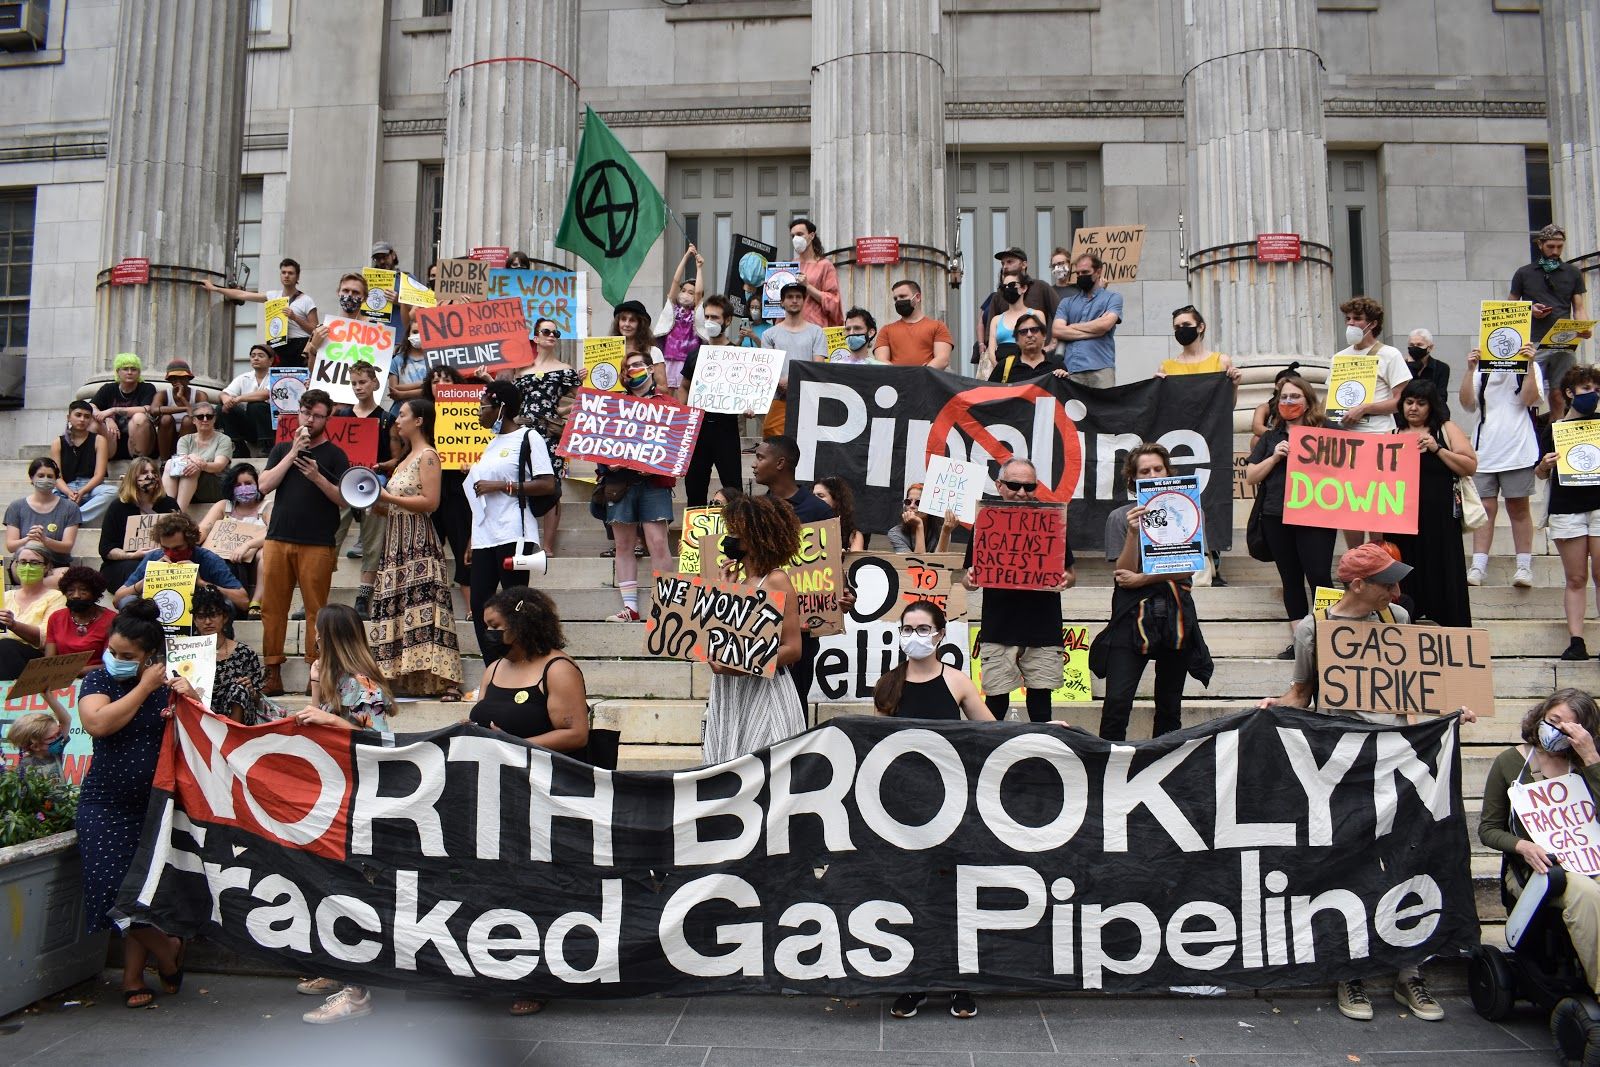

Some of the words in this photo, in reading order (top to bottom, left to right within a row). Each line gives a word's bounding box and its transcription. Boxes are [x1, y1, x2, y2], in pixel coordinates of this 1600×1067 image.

[1079, 232, 1099, 244] WE
[1106, 230, 1143, 243] WONT
[1109, 247, 1126, 261] TO
[441, 263, 463, 279] NO
[467, 263, 490, 281] BK
[440, 281, 483, 295] PIPELINE
[467, 301, 523, 322] NORTH
[527, 298, 573, 318] FOR
[327, 319, 392, 350] GRID'S
[420, 311, 464, 342] NO
[469, 319, 529, 337] BROOKLYN
[325, 342, 376, 365] GAS
[426, 343, 501, 368] PIPELINE
[707, 350, 720, 360] WE
[581, 393, 612, 415] WE
[618, 398, 680, 425] WON'T
[573, 412, 610, 434] PAY
[613, 420, 637, 438] TO
[642, 424, 670, 443] BE
[437, 436, 471, 444] DONT
[567, 433, 667, 465] POISONED
[439, 452, 482, 463] STRIK
[1297, 434, 1364, 469] SHUT
[1376, 442, 1404, 472] IT
[947, 463, 964, 474] NO
[936, 472, 968, 489] NBK
[933, 486, 965, 500] PIPE
[1286, 471, 1406, 516] DOWN
[980, 509, 1059, 533] STRIKE
[976, 531, 1056, 554] AGAINST
[976, 553, 1048, 569] RACIST
[906, 566, 938, 590] TO
[973, 566, 1063, 588] PIPELINES
[656, 576, 691, 608] WE
[691, 585, 784, 637] WON'T
[798, 592, 838, 615] PELINES
[168, 651, 197, 663] Green
[707, 627, 779, 676] PAY!
[1331, 626, 1407, 666] GAS
[1418, 633, 1486, 668] BILL
[1323, 665, 1441, 714] STRIKE
[175, 710, 614, 867] NORTH
[673, 718, 1458, 867] BROOKLYN
[1528, 781, 1568, 808] NO
[1520, 800, 1597, 833] FRACKED
[1549, 827, 1589, 850] GAS
[136, 797, 622, 983] Fracked
[658, 873, 915, 982] Gas
[957, 850, 1443, 990] Pipeline
